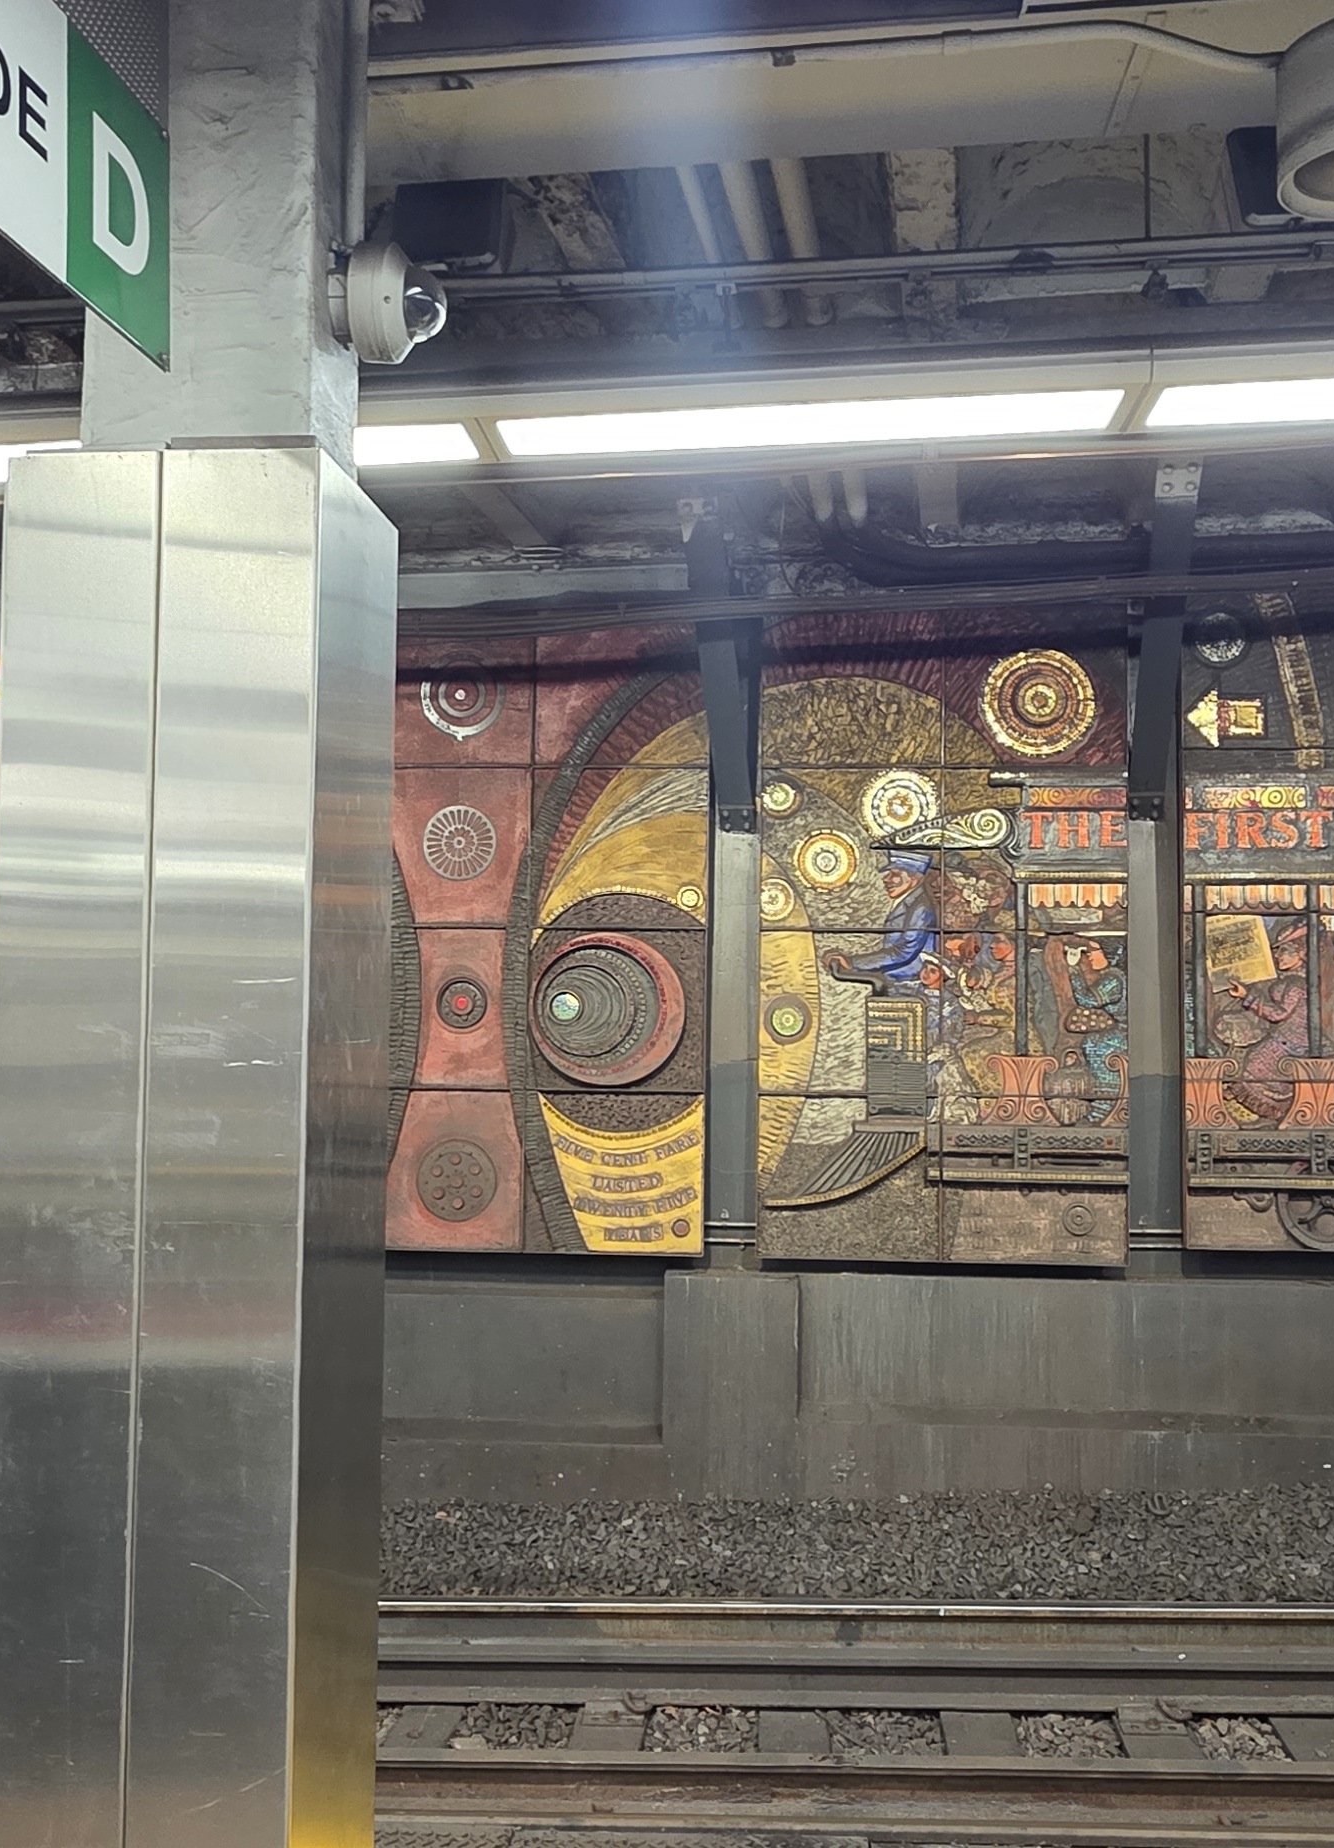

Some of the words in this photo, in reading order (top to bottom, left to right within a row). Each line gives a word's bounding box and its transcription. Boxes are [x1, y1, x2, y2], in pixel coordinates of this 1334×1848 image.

[92, 111, 150, 276] D
[1020, 811, 1128, 848] THE
[1184, 811, 1334, 849] FIRST
[556, 1135, 596, 1163] FIVE
[601, 1151, 647, 1167] CENT
[655, 1129, 700, 1161] FARE
[592, 1173, 664, 1193] LASTED
[654, 1187, 697, 1213] FIVE
